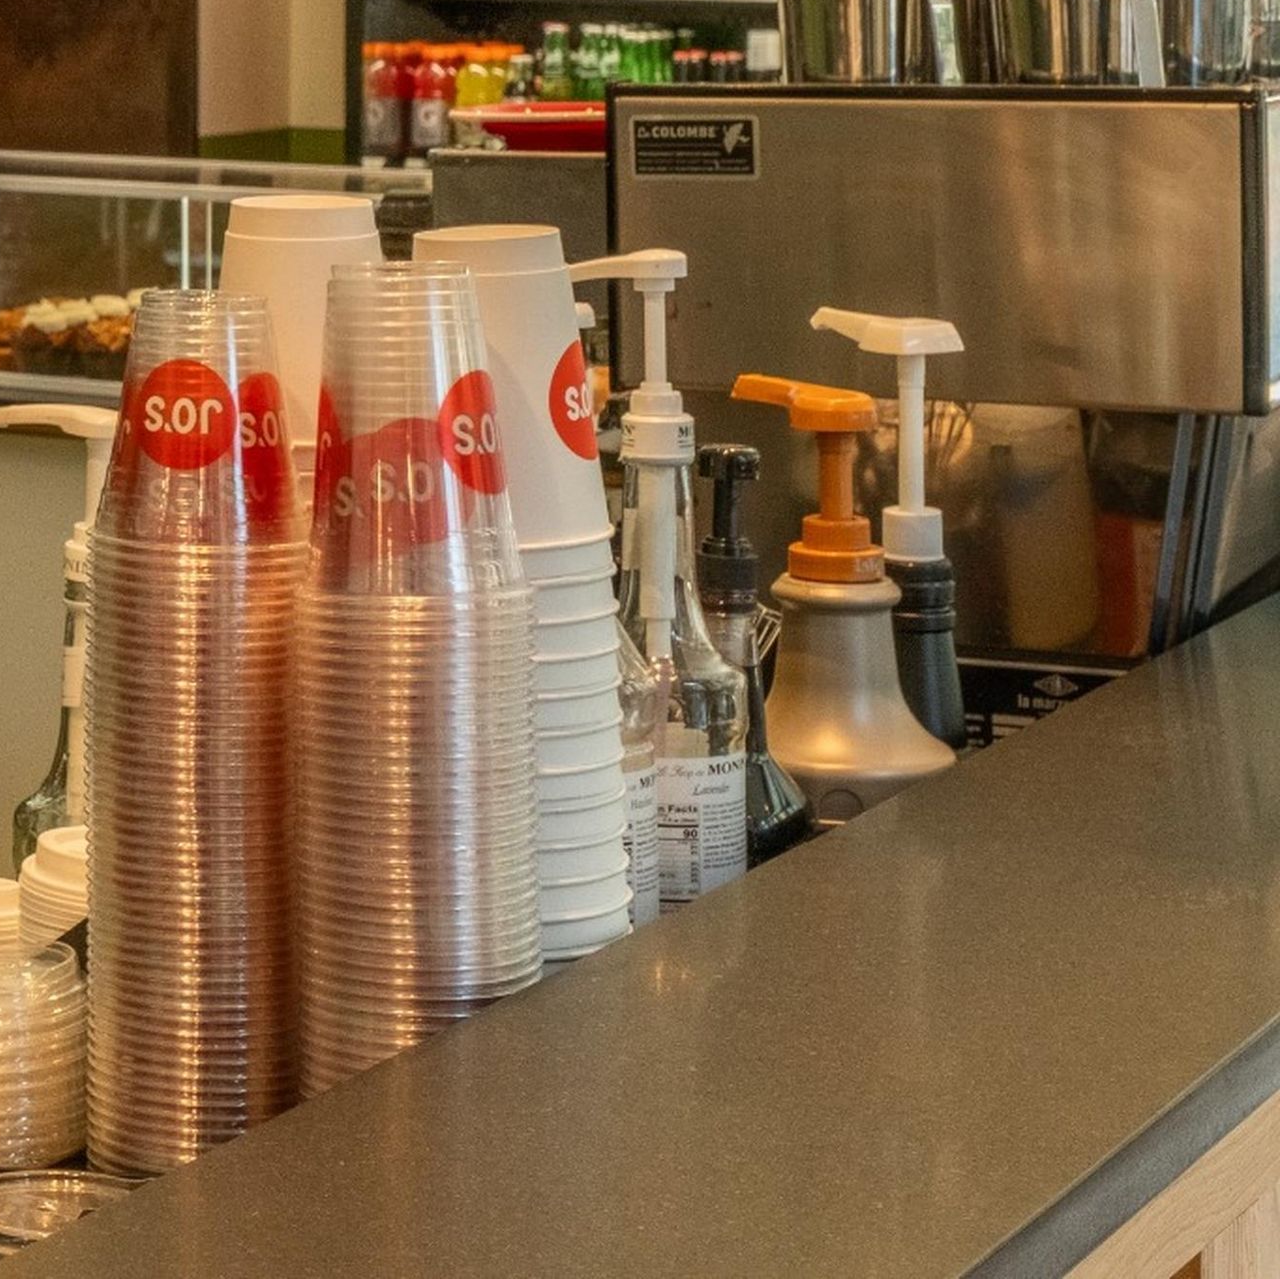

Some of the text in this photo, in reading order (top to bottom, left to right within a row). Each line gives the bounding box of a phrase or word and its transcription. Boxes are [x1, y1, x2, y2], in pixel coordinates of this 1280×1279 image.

[651, 125, 717, 139] COLOMBE
[144, 395, 224, 436] JO'S
[682, 828, 699, 839] 90
